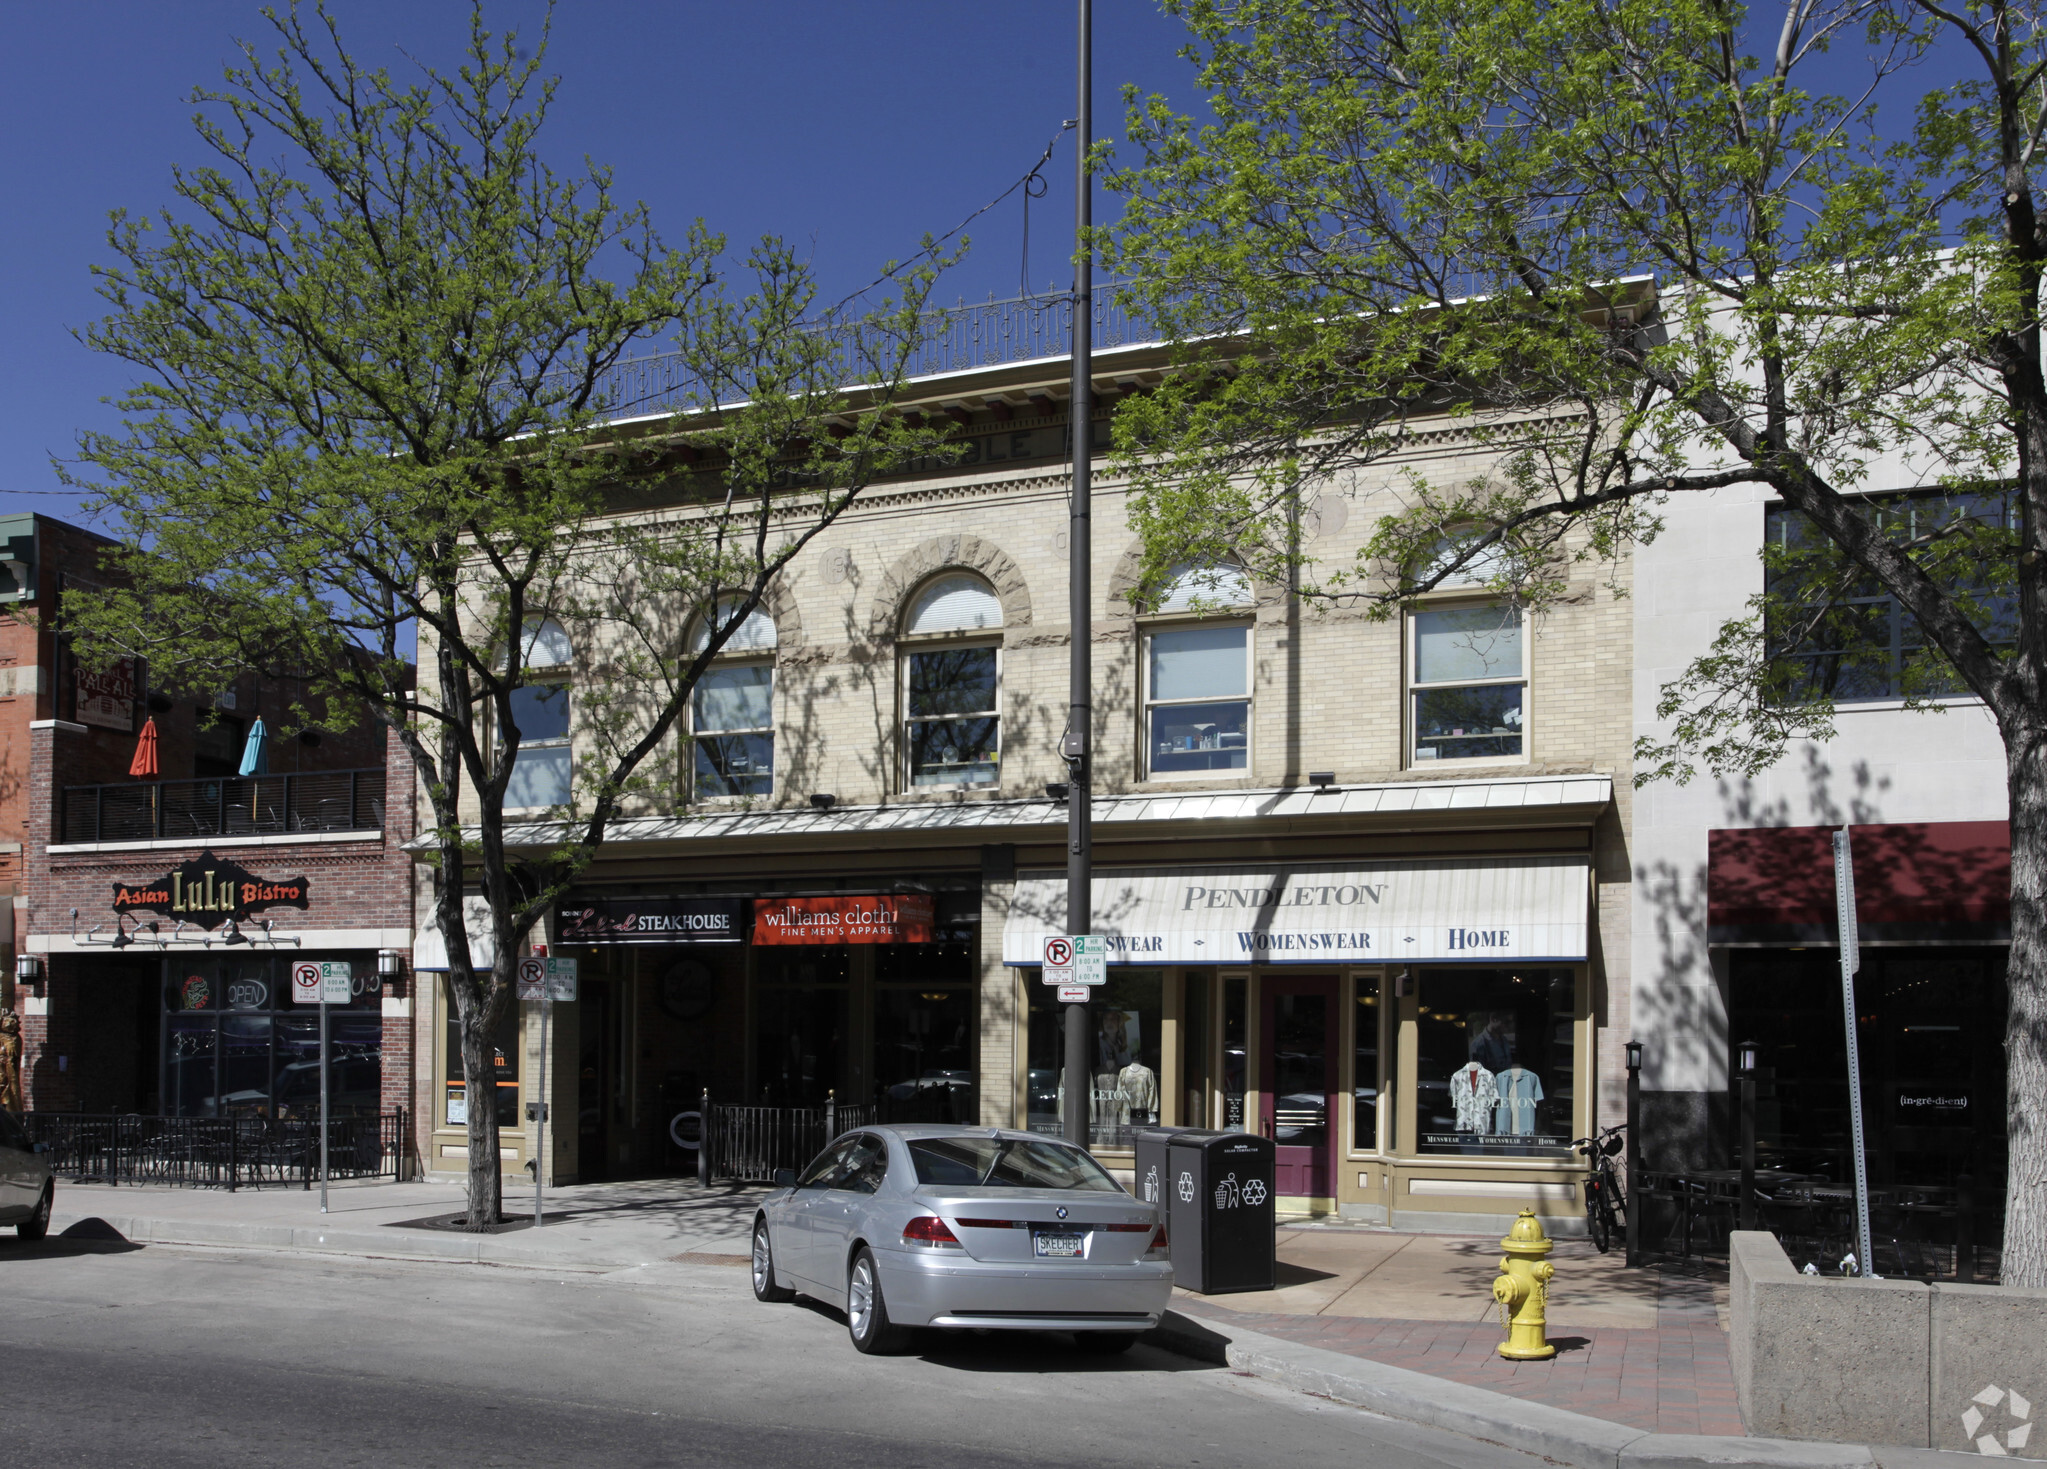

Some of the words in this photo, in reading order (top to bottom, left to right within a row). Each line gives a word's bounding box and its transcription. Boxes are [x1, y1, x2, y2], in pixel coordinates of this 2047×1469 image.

[73, 667, 111, 695] PALE
[115, 887, 170, 906] Asian
[241, 883, 300, 904] Bistro
[1181, 884, 1384, 911] PENDLETON
[638, 914, 730, 931] STEAKHOUSE
[765, 904, 840, 926] williams
[781, 928, 806, 936] FINE
[811, 926, 844, 936] MEN'S
[850, 926, 900, 935] APPAREL
[1076, 939, 1084, 952] 2
[1105, 935, 1163, 952] SWEAR
[1236, 931, 1371, 952] WOMENSWEAR
[1448, 928, 1510, 950] HOME
[323, 965, 330, 976] 2
[549, 961, 556, 971] 2
[228, 985, 260, 1003] OPEN
[1041, 1237, 1079, 1250] SKECHER
